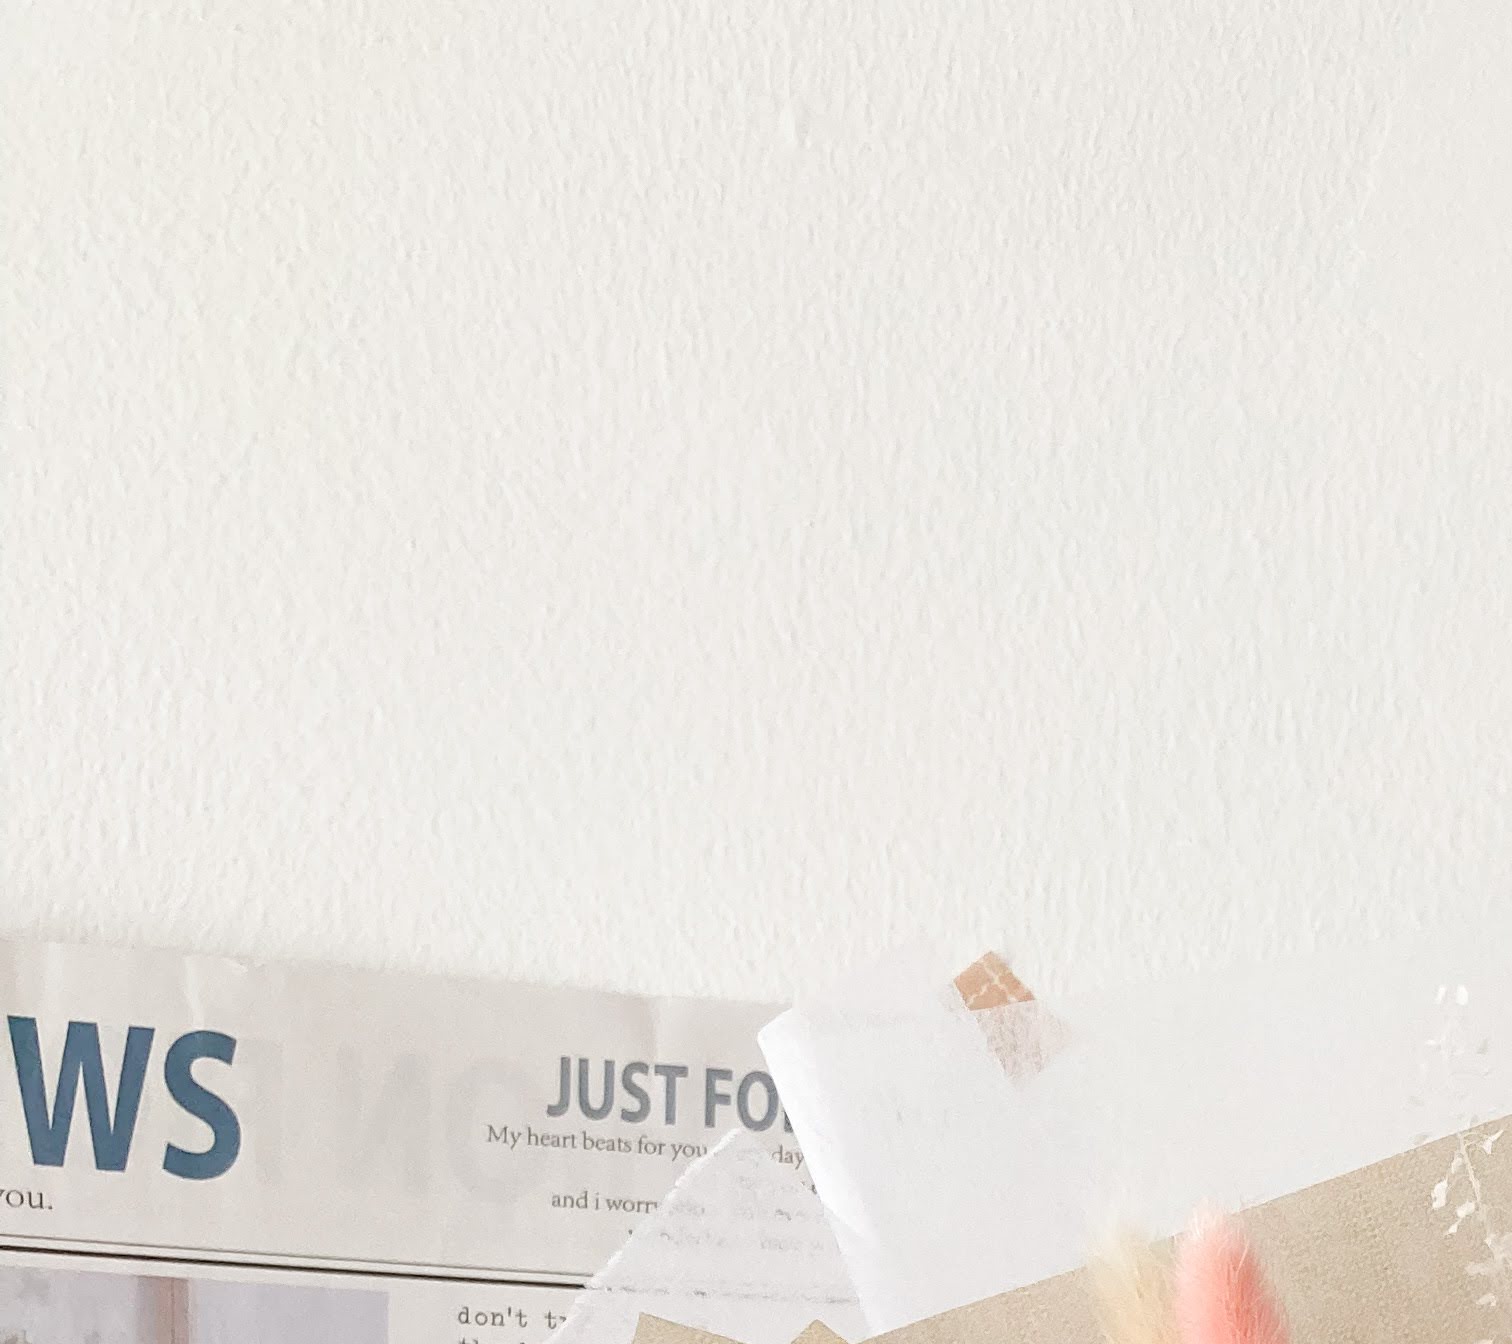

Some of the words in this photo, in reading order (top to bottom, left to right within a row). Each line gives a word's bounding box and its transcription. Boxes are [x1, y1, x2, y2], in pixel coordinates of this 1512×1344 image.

[7, 1014, 241, 1181] WS
[546, 1056, 688, 1125] JUST
[704, 1067, 794, 1133] FO
[487, 1124, 521, 1151] My
[527, 1127, 577, 1150] heart
[582, 1130, 632, 1154] beats
[637, 1135, 667, 1157] for
[551, 1190, 589, 1210] and
[594, 1191, 601, 1213] i
[457, 1306, 529, 1328] don't
